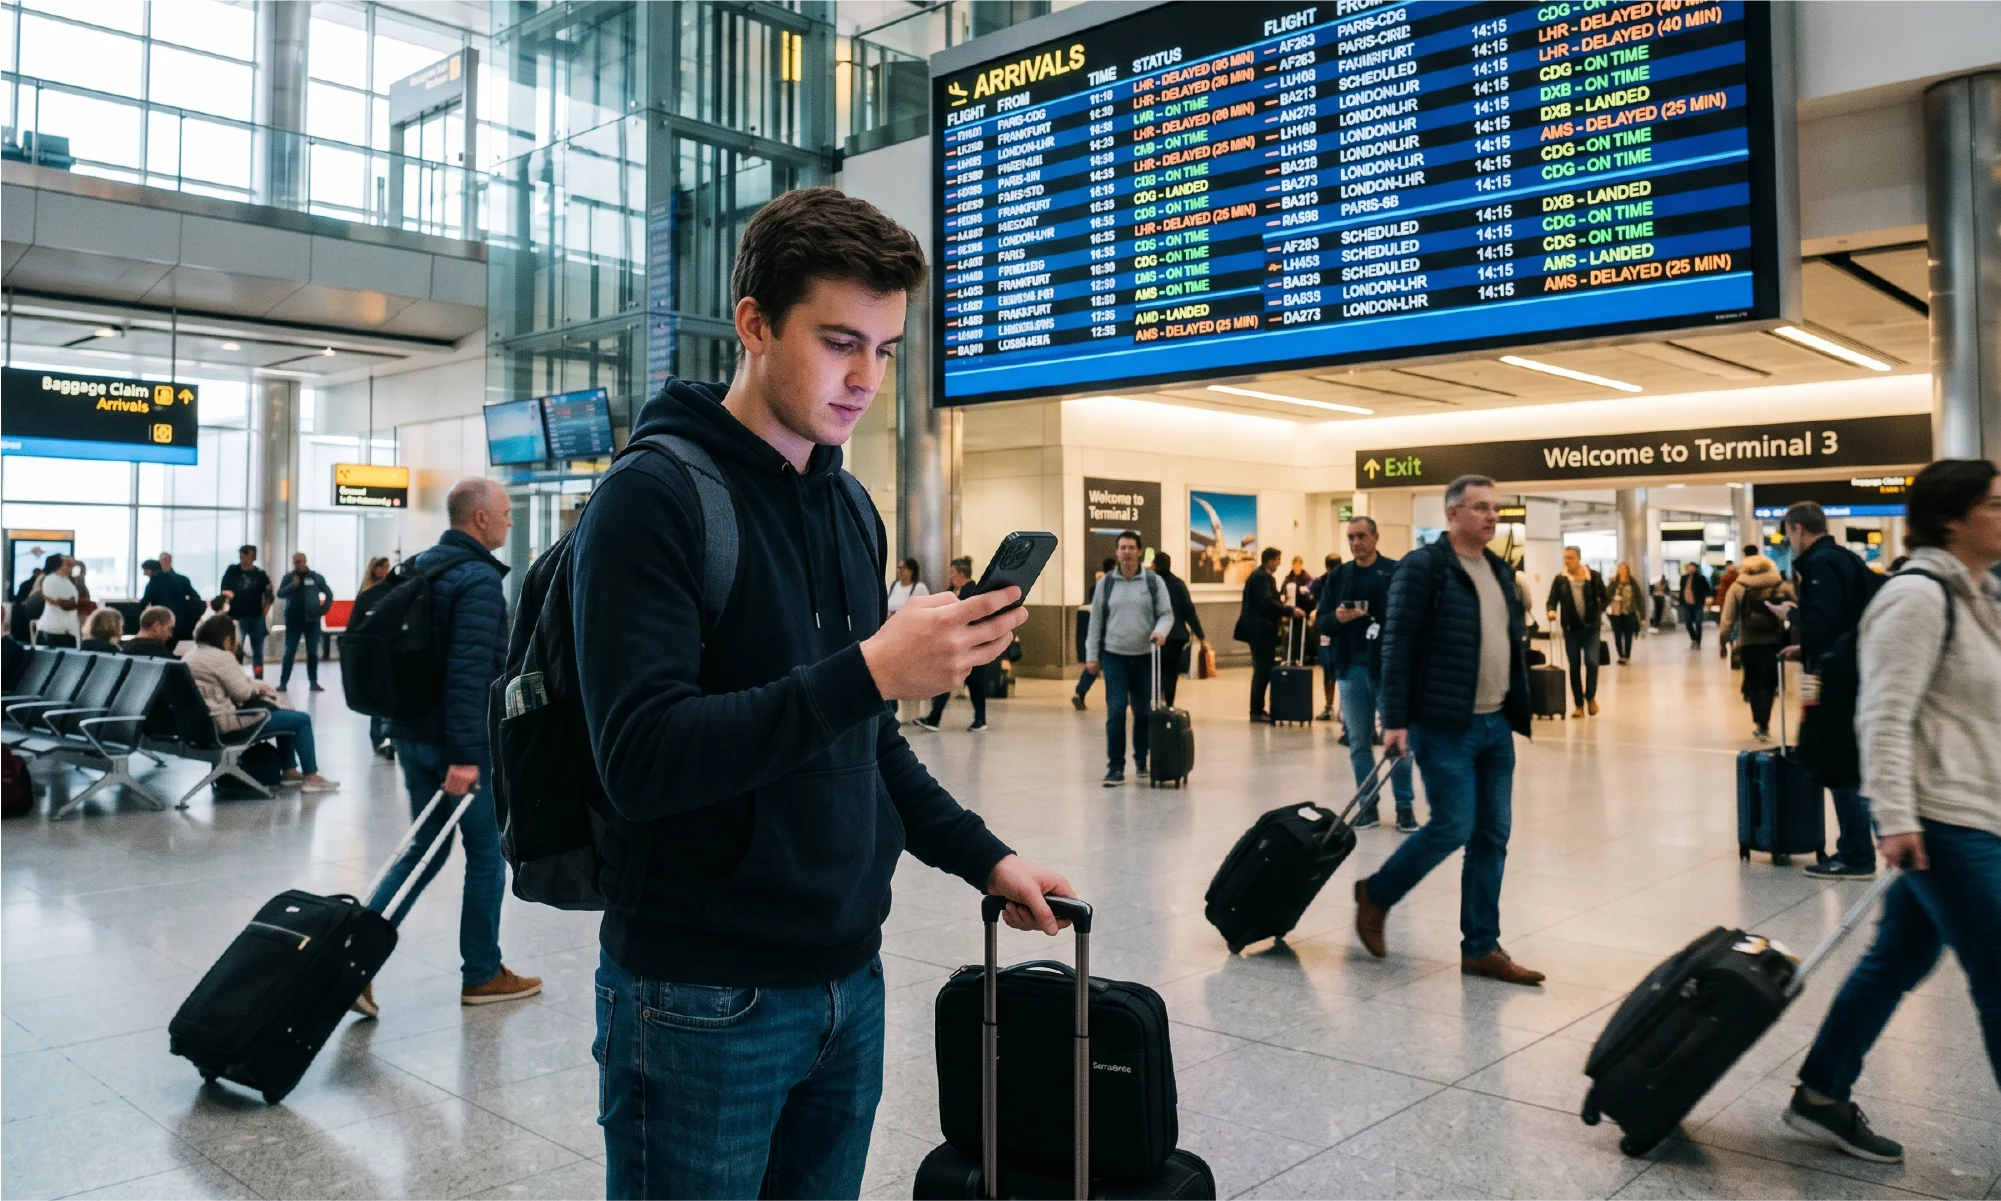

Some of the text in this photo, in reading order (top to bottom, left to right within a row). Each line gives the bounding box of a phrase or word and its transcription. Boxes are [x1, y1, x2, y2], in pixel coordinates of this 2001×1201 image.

[1264, 8, 1317, 36] FLIGHT
[1337, 7, 1406, 39] PARIS-CDG
[1471, 18, 1507, 41] 14:15
[1537, 1, 1570, 23] CDG
[1280, 0, 1681, 106] BA213 SCHEDULED 14:15 LHR DELAYED (40
[1472, 6, 1722, 79] 14:15 LHR DELAYED (40 MIN)
[947, 47, 1182, 126] FLIGHT FROM TIME STATUS
[974, 44, 1085, 99] ARRIVALS
[1133, 77, 1154, 93] LHR
[1161, 61, 1210, 85] DELAYED
[1230, 49, 1254, 67] MIN)
[1133, 93, 1154, 109] LHR
[1161, 78, 1210, 102] DELAYED
[1230, 67, 1254, 84] MIN)
[1472, 76, 1508, 98] 14:15
[1539, 61, 1572, 82] CDG
[1584, 53, 1608, 72] ON
[1610, 43, 1649, 66] TIME
[1164, 102, 1181, 117] ON
[1182, 95, 1208, 113] TIME
[1473, 95, 1509, 117] 14:15
[1540, 81, 1571, 102] DXB
[1584, 73, 1608, 92] ON
[1610, 64, 1650, 87] TIME
[1133, 125, 1154, 141] LHR
[1162, 111, 1210, 135] DELAYED
[1230, 100, 1254, 118] MIN)
[1474, 114, 1510, 136] 14:15
[1540, 101, 1571, 121] DXB
[1585, 85, 1650, 112] LANDED
[1474, 134, 1510, 155] 14:15
[1540, 121, 1574, 141] AMS
[1585, 104, 1657, 132] DELAYED
[1660, 99, 1686, 120] (25
[1690, 91, 1726, 112] MIN)
[1134, 157, 1155, 173] LHR
[1162, 144, 1210, 166] DELAYED
[1230, 134, 1255, 152] MIN)
[1164, 134, 1181, 150] ON
[1181, 128, 1208, 146] TIME
[1164, 167, 1181, 182] ON
[1182, 161, 1209, 179] TIME
[1340, 170, 1425, 199] LONDON-LHR
[1474, 154, 1511, 174] 14:15
[1540, 141, 1575, 161] CDG
[1586, 134, 1610, 153] ON
[1612, 126, 1651, 148] TIME
[1475, 173, 1511, 193] 14:15
[1541, 160, 1575, 181] CDG
[1586, 154, 1611, 173] ON
[1613, 146, 1652, 168] TIME
[1133, 177, 1208, 205] CDG LANDED
[1164, 200, 1182, 215] ON
[1182, 194, 1209, 212] TIME
[1134, 221, 1156, 236] LHR
[1163, 211, 1211, 231] DELAYED
[1230, 202, 1256, 219] MIN)
[1340, 219, 1419, 245] SCHEDULED
[1475, 203, 1512, 224] 14:15
[1542, 193, 1574, 212] DXB
[1587, 180, 1651, 205] LANDED
[1341, 238, 1419, 263] SCHEDULED
[1476, 223, 1512, 243] 14:15
[1542, 212, 1576, 232] CDG
[1587, 207, 1612, 225] ON
[1614, 200, 1653, 221] TIME
[1165, 233, 1182, 248] ON
[1182, 228, 1209, 245] TIME
[1165, 249, 1182, 264] ON
[1183, 244, 1209, 261] TIME
[1341, 221, 1653, 281] SCHEDULED 14:15 CDG ON TIME
[1134, 278, 1210, 301] AMS ON TIME
[1165, 265, 1182, 280] ON
[1183, 261, 1210, 277] TIME
[1342, 242, 1654, 299] LONDON-LHR 14:15 AMS LANDED
[1342, 293, 1428, 317] LONDON-LHR
[1478, 282, 1514, 301] 14:15
[1544, 273, 1577, 291] AMS
[1590, 262, 1662, 285] DELAYED
[1665, 258, 1690, 279] (25
[1694, 253, 1731, 273] MIN)
[1165, 319, 1214, 337] DELAYED
[1233, 313, 1258, 329] MIN)
[1166, 303, 1209, 321] LANDED
[42, 376, 149, 398] Baggage Claim
[96, 397, 149, 413] Arrivals
[1385, 456, 1422, 477] Exit
[1543, 431, 1838, 469] Welcome to Terminal 3
[1088, 490, 1144, 505] Welcome to
[1088, 505, 1138, 521] Terminal 3
